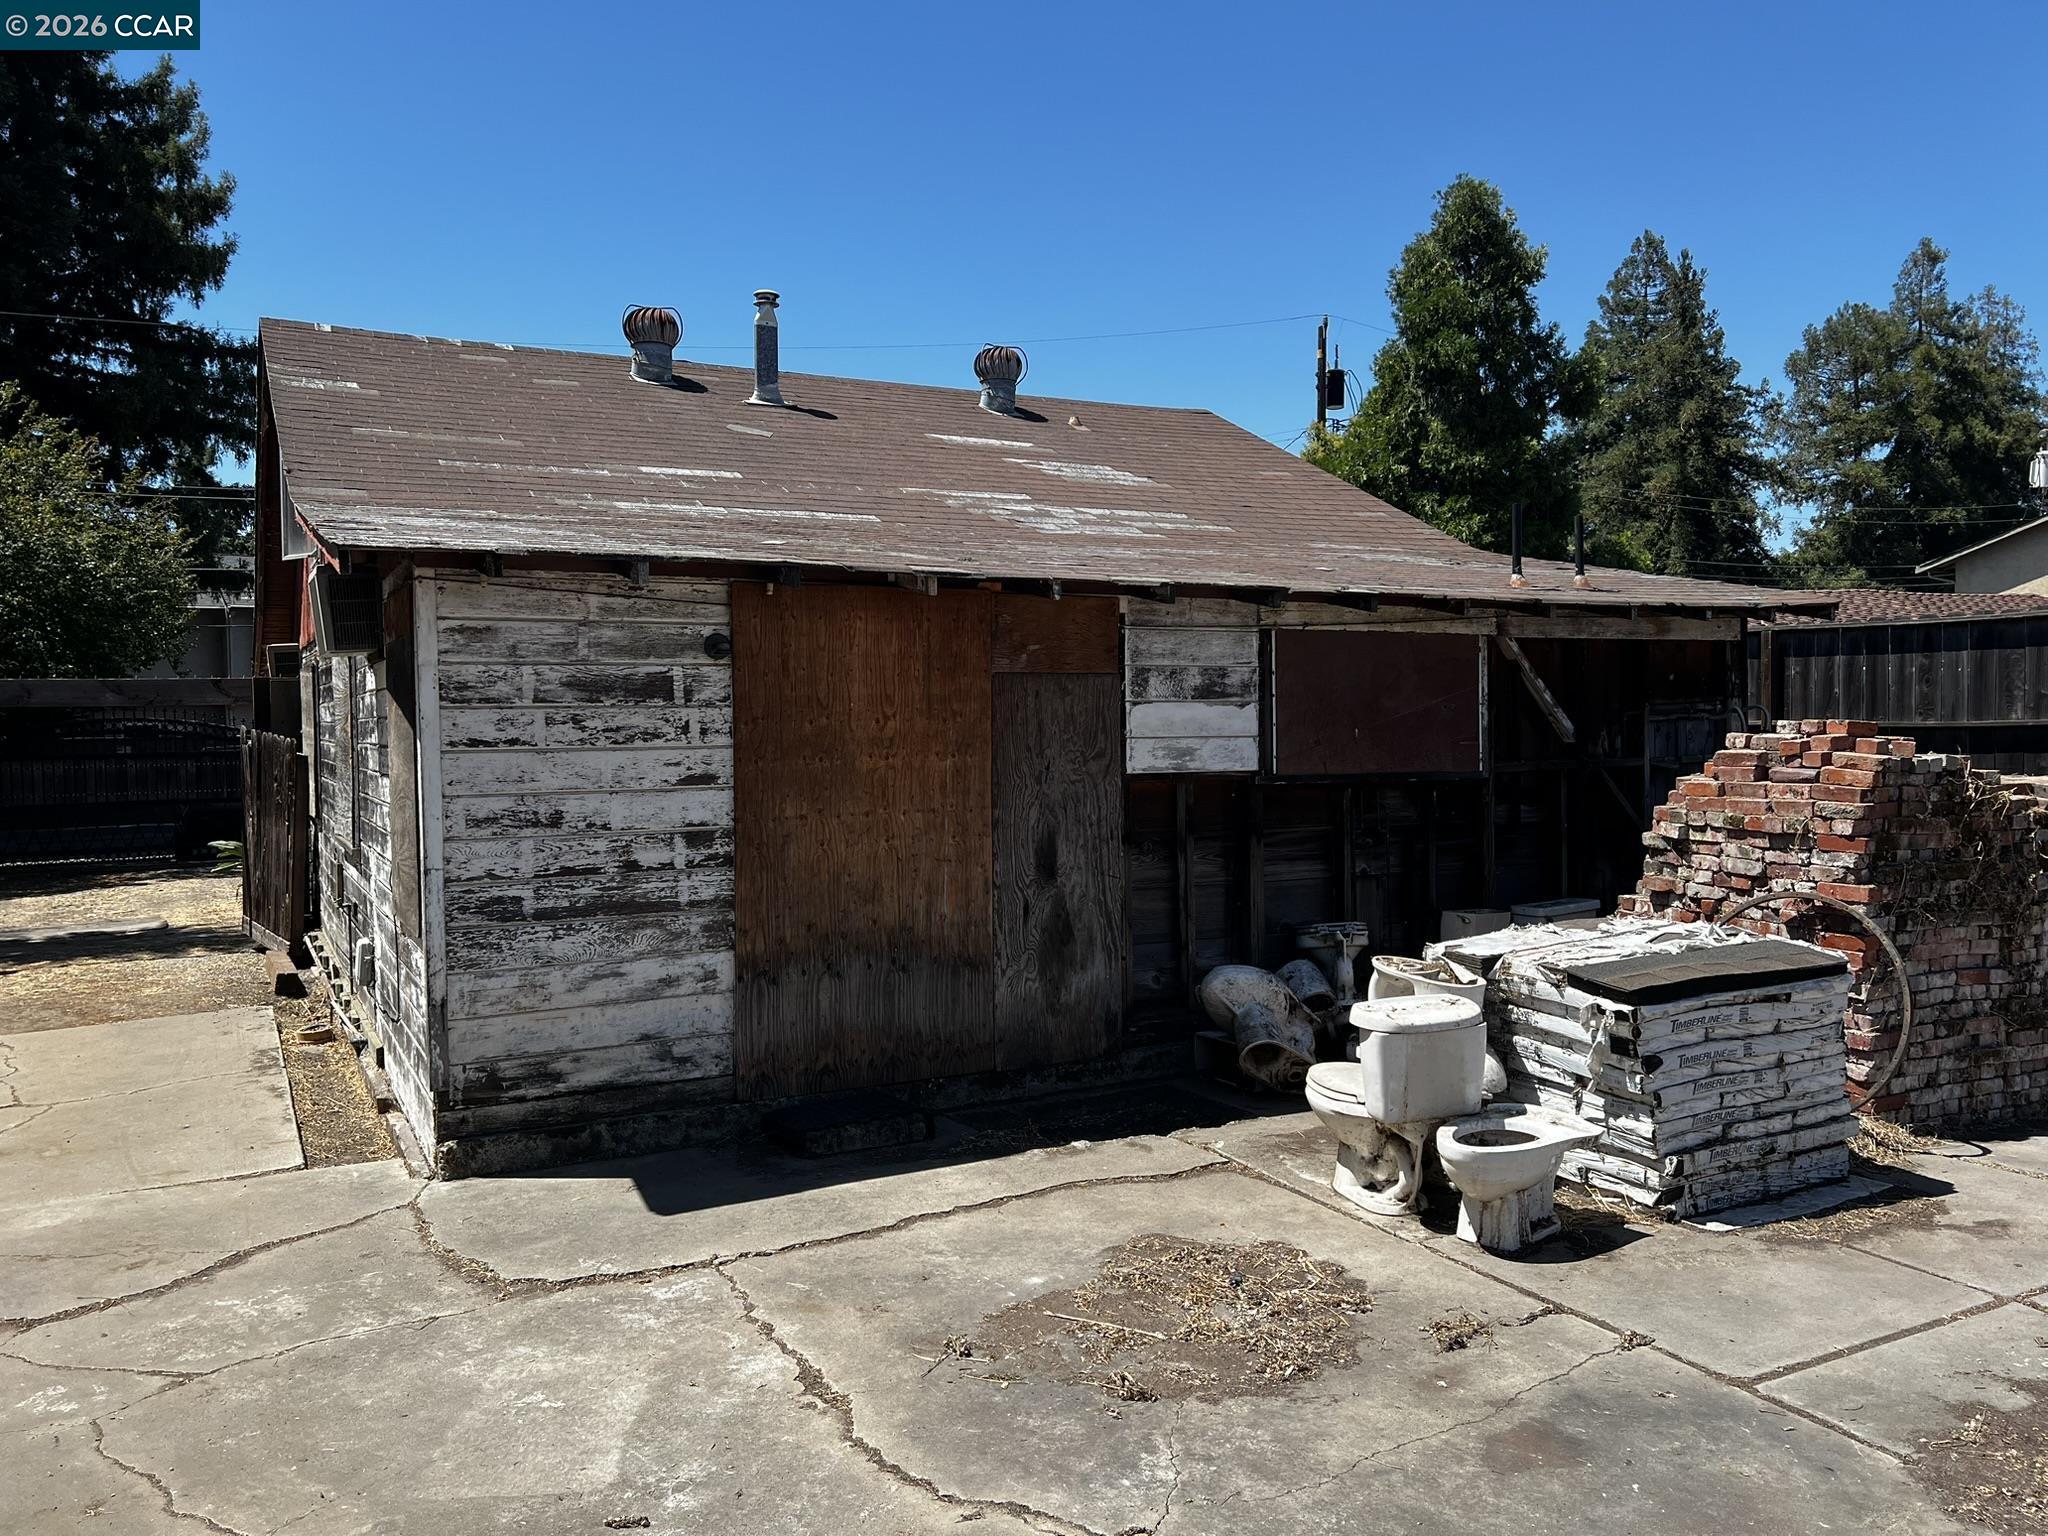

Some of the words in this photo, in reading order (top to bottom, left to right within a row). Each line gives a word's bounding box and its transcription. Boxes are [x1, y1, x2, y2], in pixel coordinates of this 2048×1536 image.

[1670, 1014, 1722, 1033] TIMBERLINE
[1677, 1049, 1729, 1068] TIMBERLINE
[1691, 1075, 1739, 1096] TIMBERLINE
